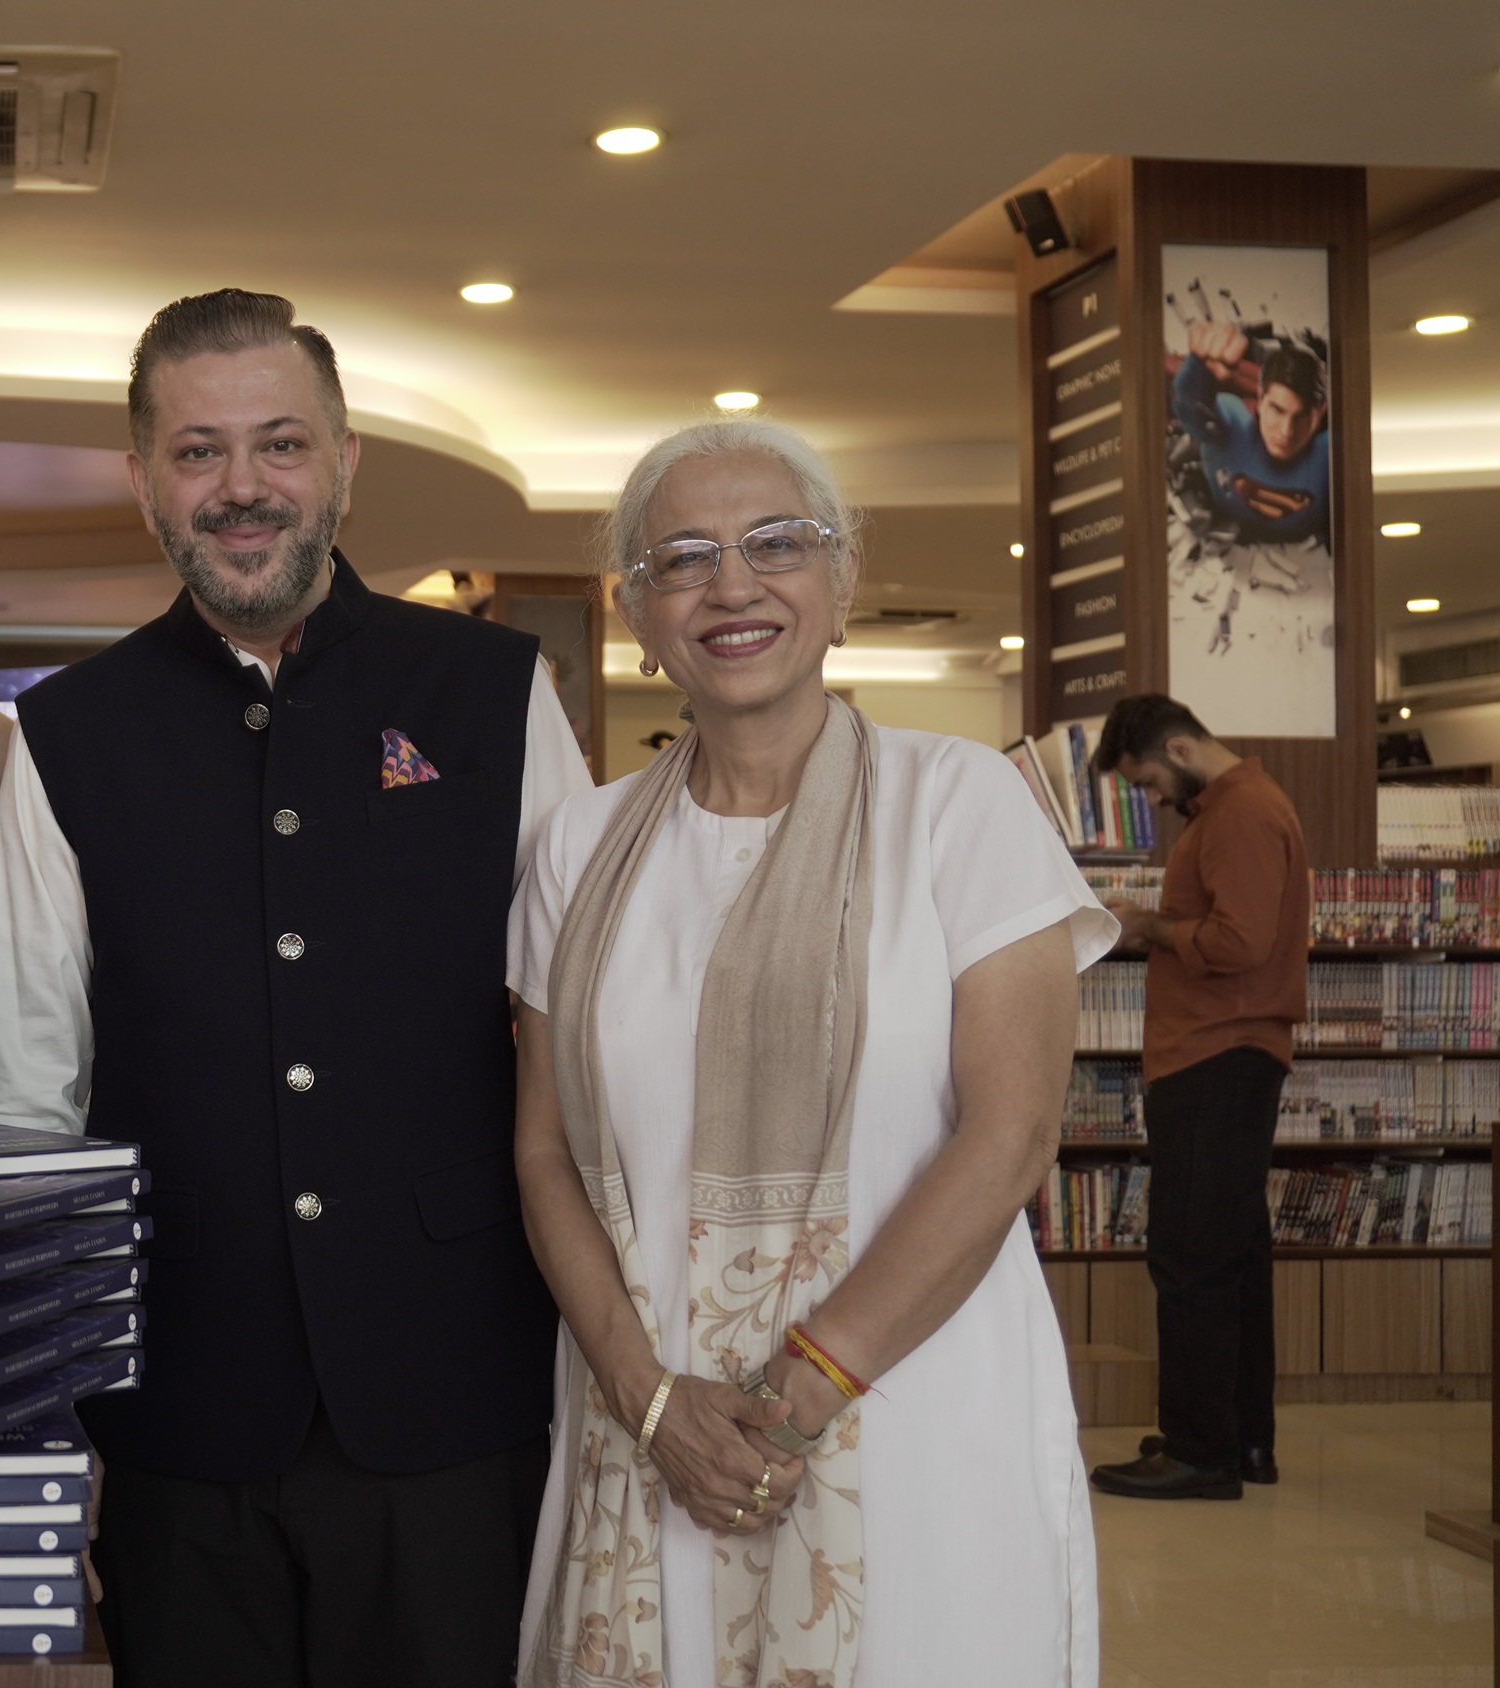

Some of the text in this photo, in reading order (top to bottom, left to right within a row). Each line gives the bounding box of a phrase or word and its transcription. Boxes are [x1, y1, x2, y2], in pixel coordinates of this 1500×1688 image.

[1090, 446, 1098, 463] &
[1075, 593, 1117, 618] FASHION
[1063, 677, 1086, 697] ARTS
[1087, 675, 1094, 693] &
